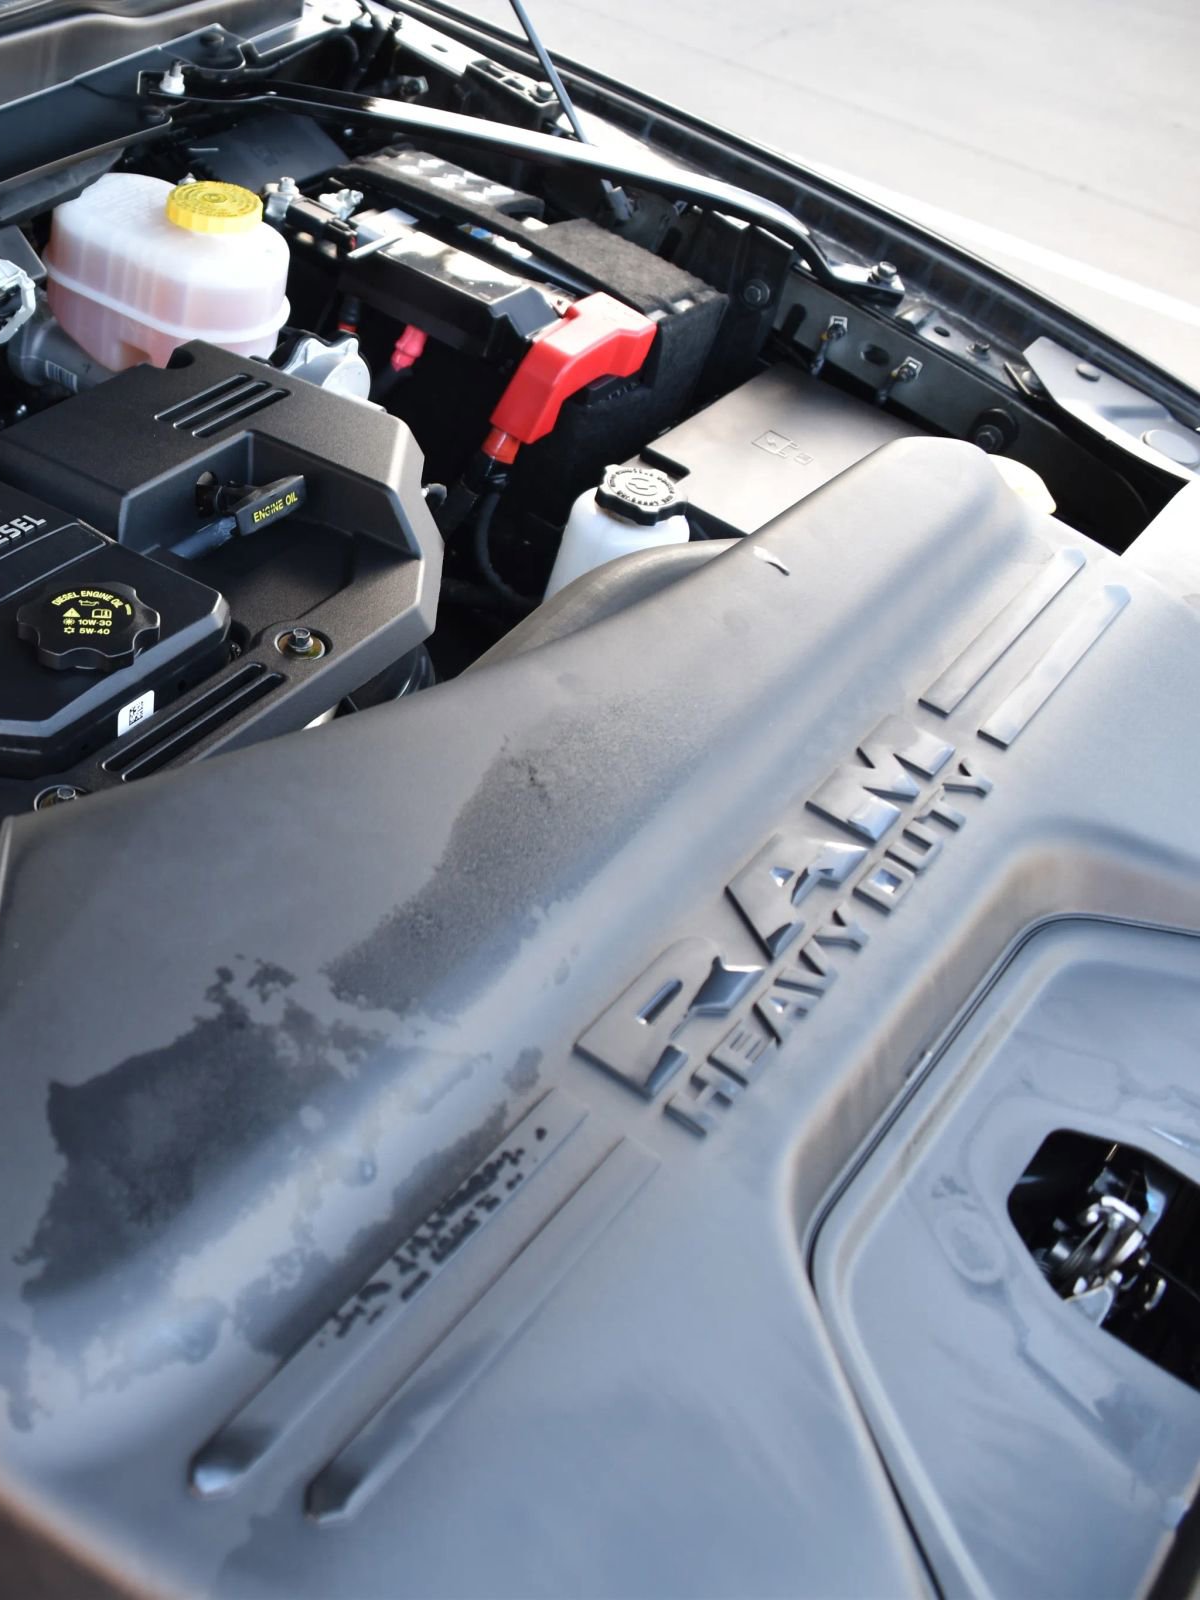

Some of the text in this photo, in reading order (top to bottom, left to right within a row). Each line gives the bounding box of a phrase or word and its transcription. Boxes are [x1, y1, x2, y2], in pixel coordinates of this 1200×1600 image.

[51, 591, 80, 606] DIESEL
[80, 590, 114, 602] ENGINE
[253, 491, 298, 523] ENGINE OIL
[573, 714, 957, 1100] RAM
[663, 757, 994, 1138] HEAVY DUTY
